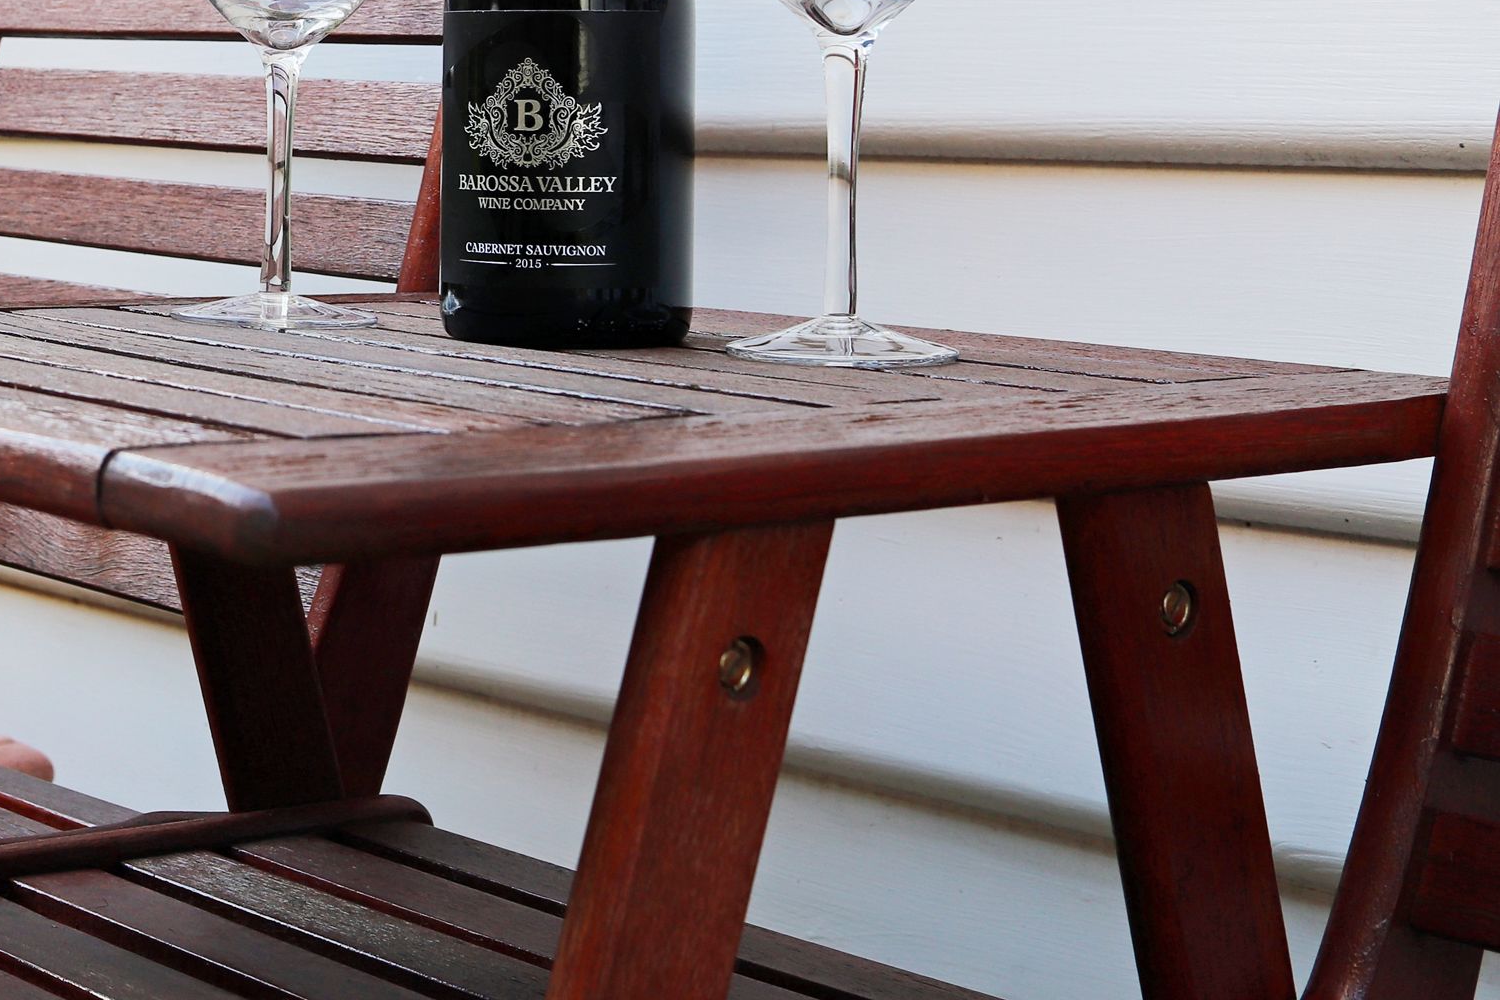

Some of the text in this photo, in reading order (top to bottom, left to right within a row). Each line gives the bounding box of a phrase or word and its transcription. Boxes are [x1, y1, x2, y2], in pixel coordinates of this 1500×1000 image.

[513, 98, 544, 132] B
[458, 173, 617, 193] BAROSSA VALLEY
[478, 196, 586, 211] WINE COMPANY
[465, 241, 606, 256] CABERNET SAUVIGNON
[515, 258, 542, 269] 2015
